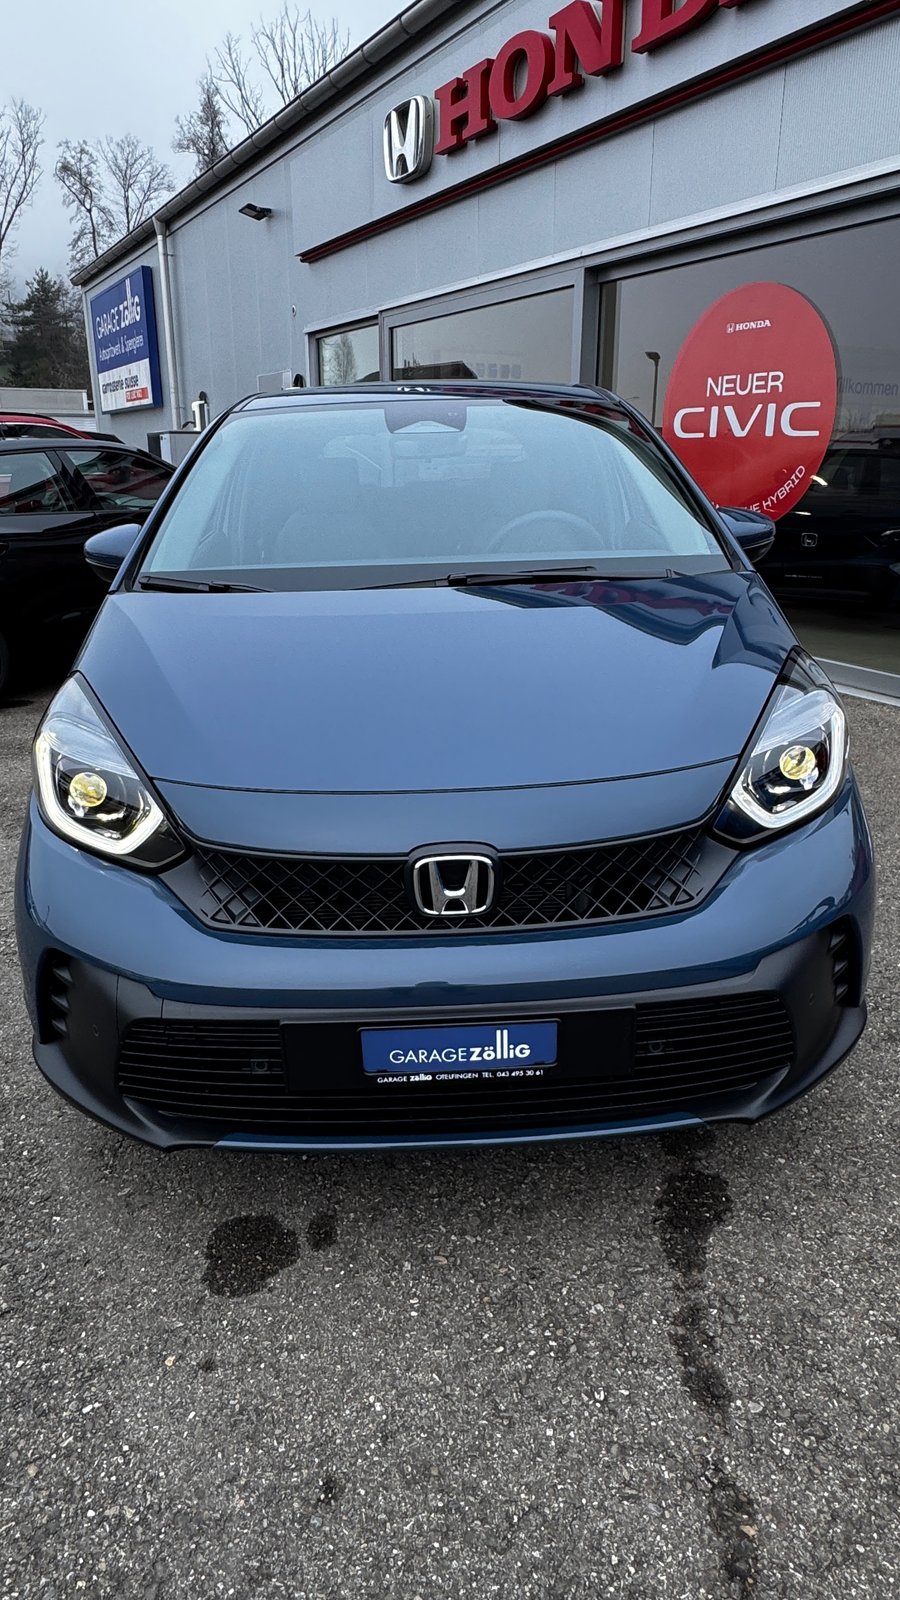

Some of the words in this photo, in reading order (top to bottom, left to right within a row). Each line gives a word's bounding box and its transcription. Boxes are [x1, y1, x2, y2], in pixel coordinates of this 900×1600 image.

[96, 306, 120, 339] GARAGE
[735, 319, 772, 332] HONDA
[706, 371, 784, 397] NEUER
[838, 377, 899, 396] illkommen
[673, 401, 821, 439] CIVIC
[762, 465, 806, 510] HYBRID
[389, 1047, 467, 1064] GARAGE
[377, 1075, 408, 1084] GARAGE
[435, 1072, 479, 1081] OTELFINGEN
[482, 1071, 495, 1079] TEL.
[496, 1070, 510, 1078] 043
[511, 1069, 524, 1077] 495
[525, 1069, 535, 1077] 30
